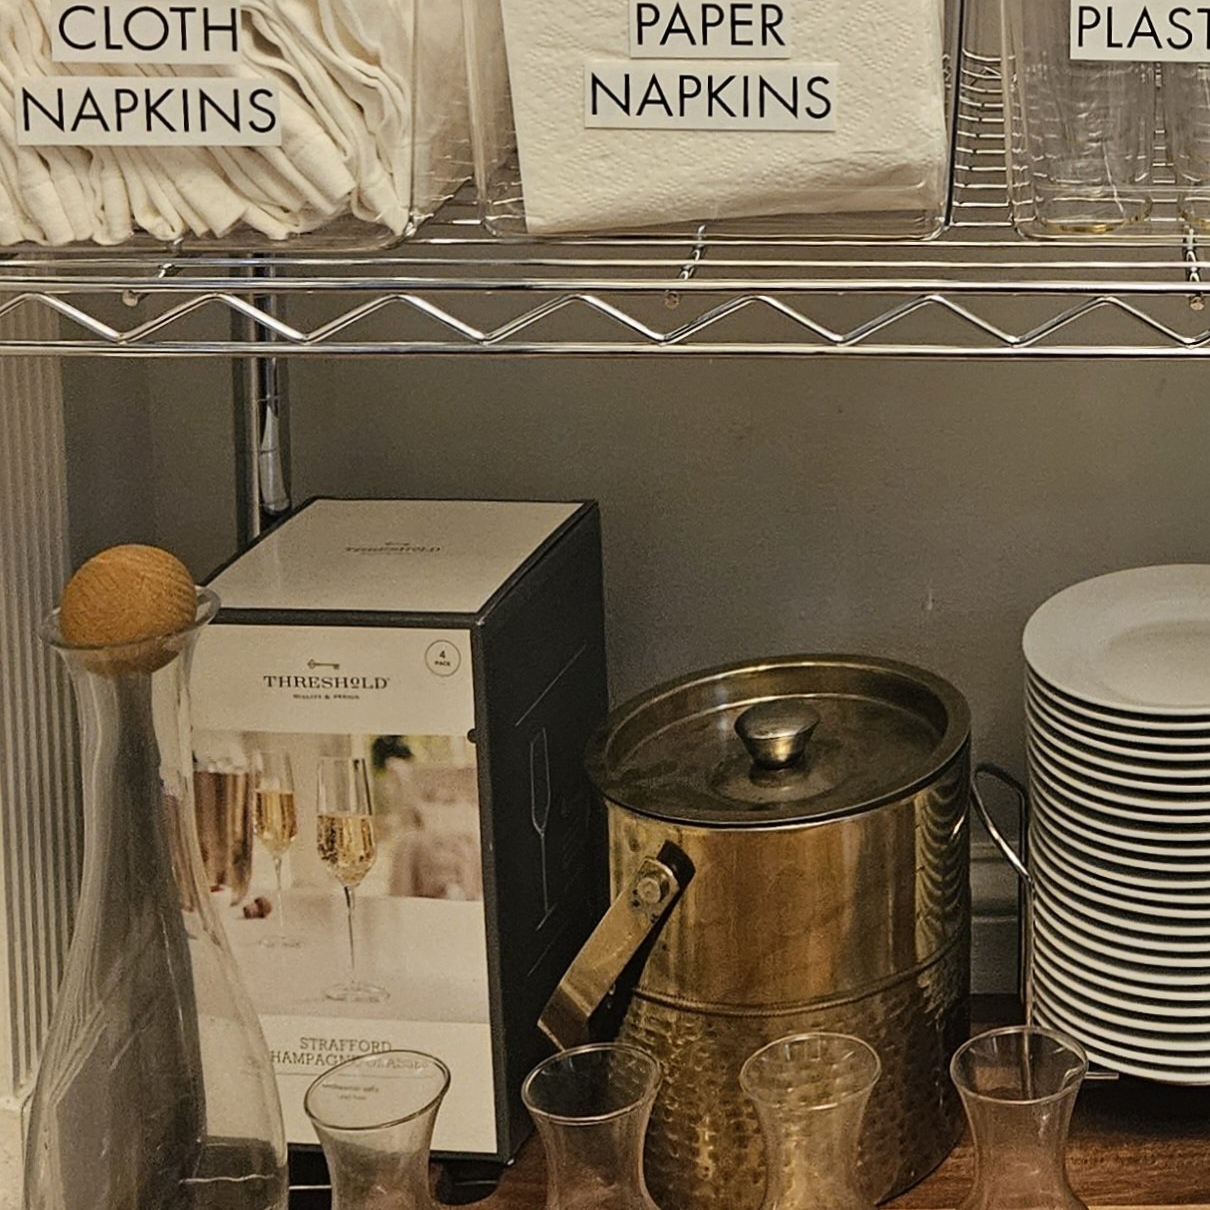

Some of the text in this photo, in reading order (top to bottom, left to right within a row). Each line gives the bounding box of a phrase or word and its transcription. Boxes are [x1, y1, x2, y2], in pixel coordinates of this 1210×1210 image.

[58, 4, 239, 52] CLOTH
[636, 1, 785, 46] PAPER
[21, 87, 277, 134] NAPKINS
[590, 72, 832, 120] NAPKINS
[439, 650, 446, 659] 4
[263, 675, 388, 689] THRESHOLD
[300, 1037, 392, 1054] STRAFFORD
